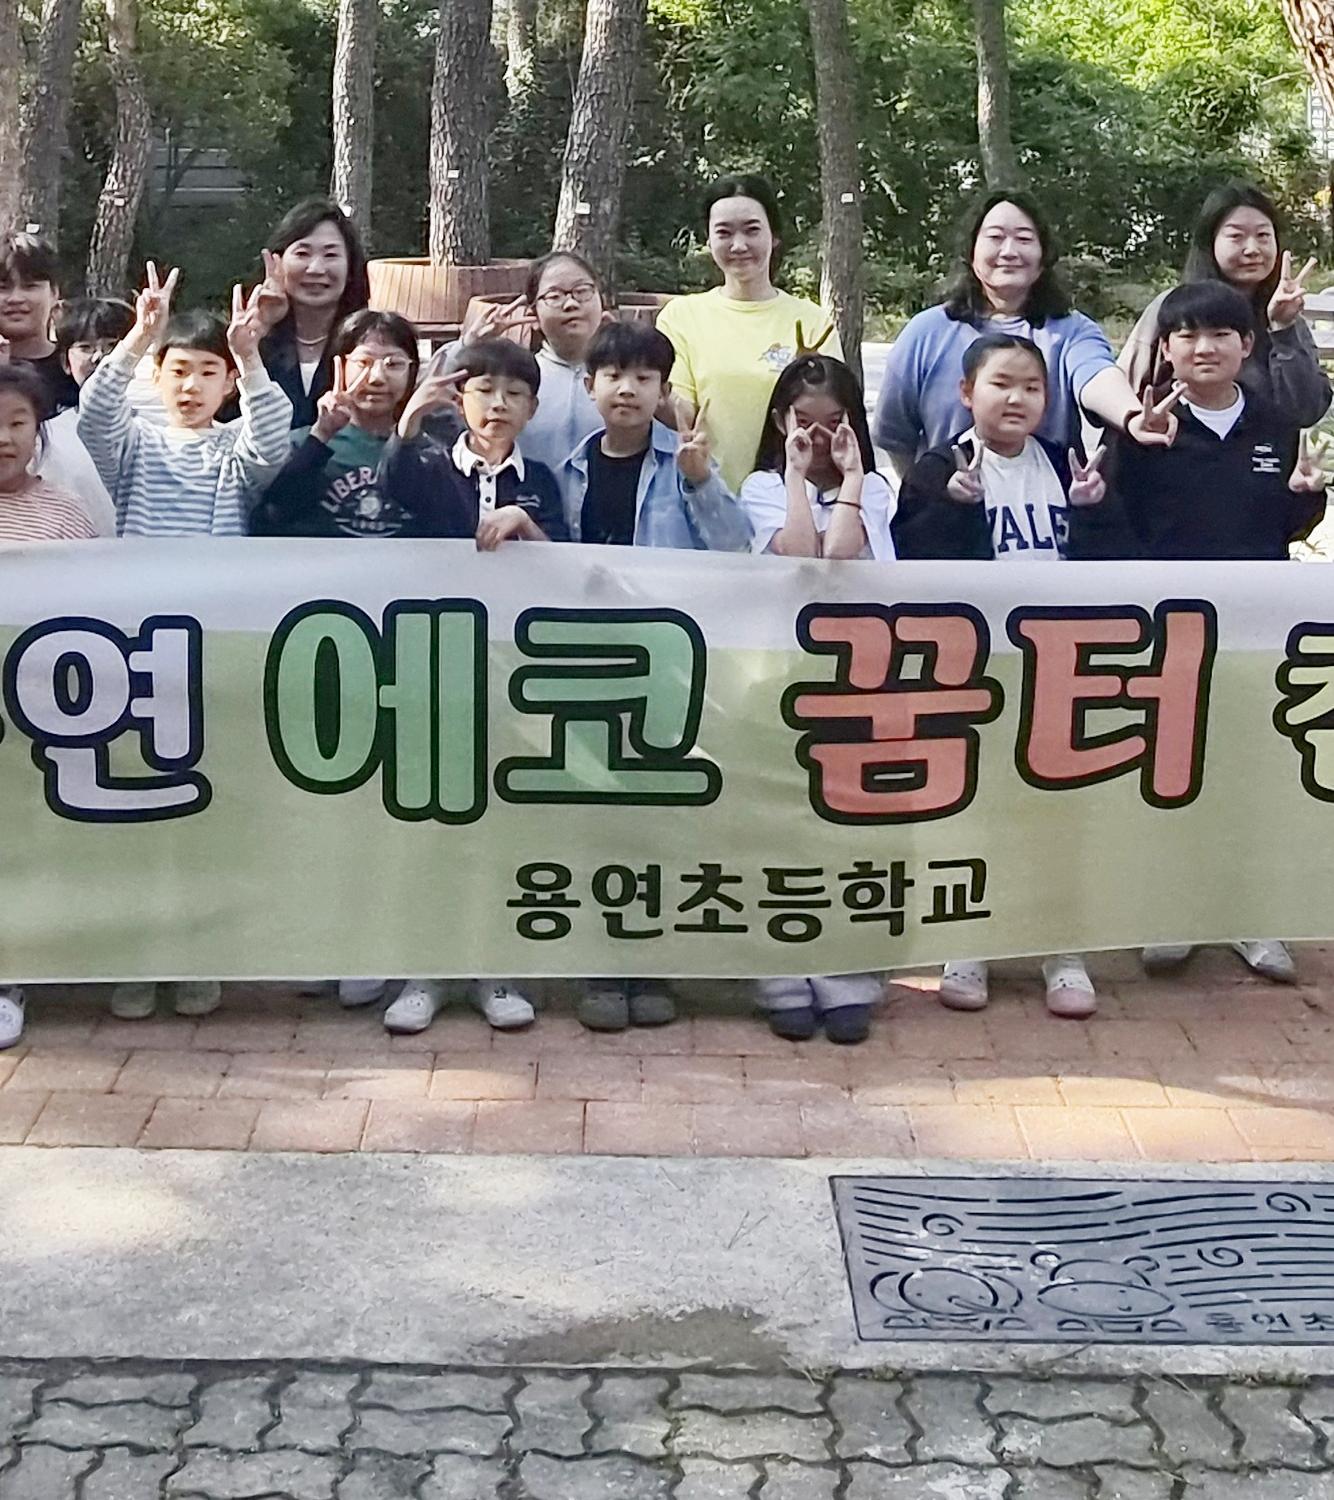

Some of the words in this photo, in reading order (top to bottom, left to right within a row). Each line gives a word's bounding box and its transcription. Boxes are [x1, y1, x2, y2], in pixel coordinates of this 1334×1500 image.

[264, 598, 723, 825] 에코
[781, 598, 1219, 825] 꿈터
[506, 857, 992, 943] 용연초등학교
